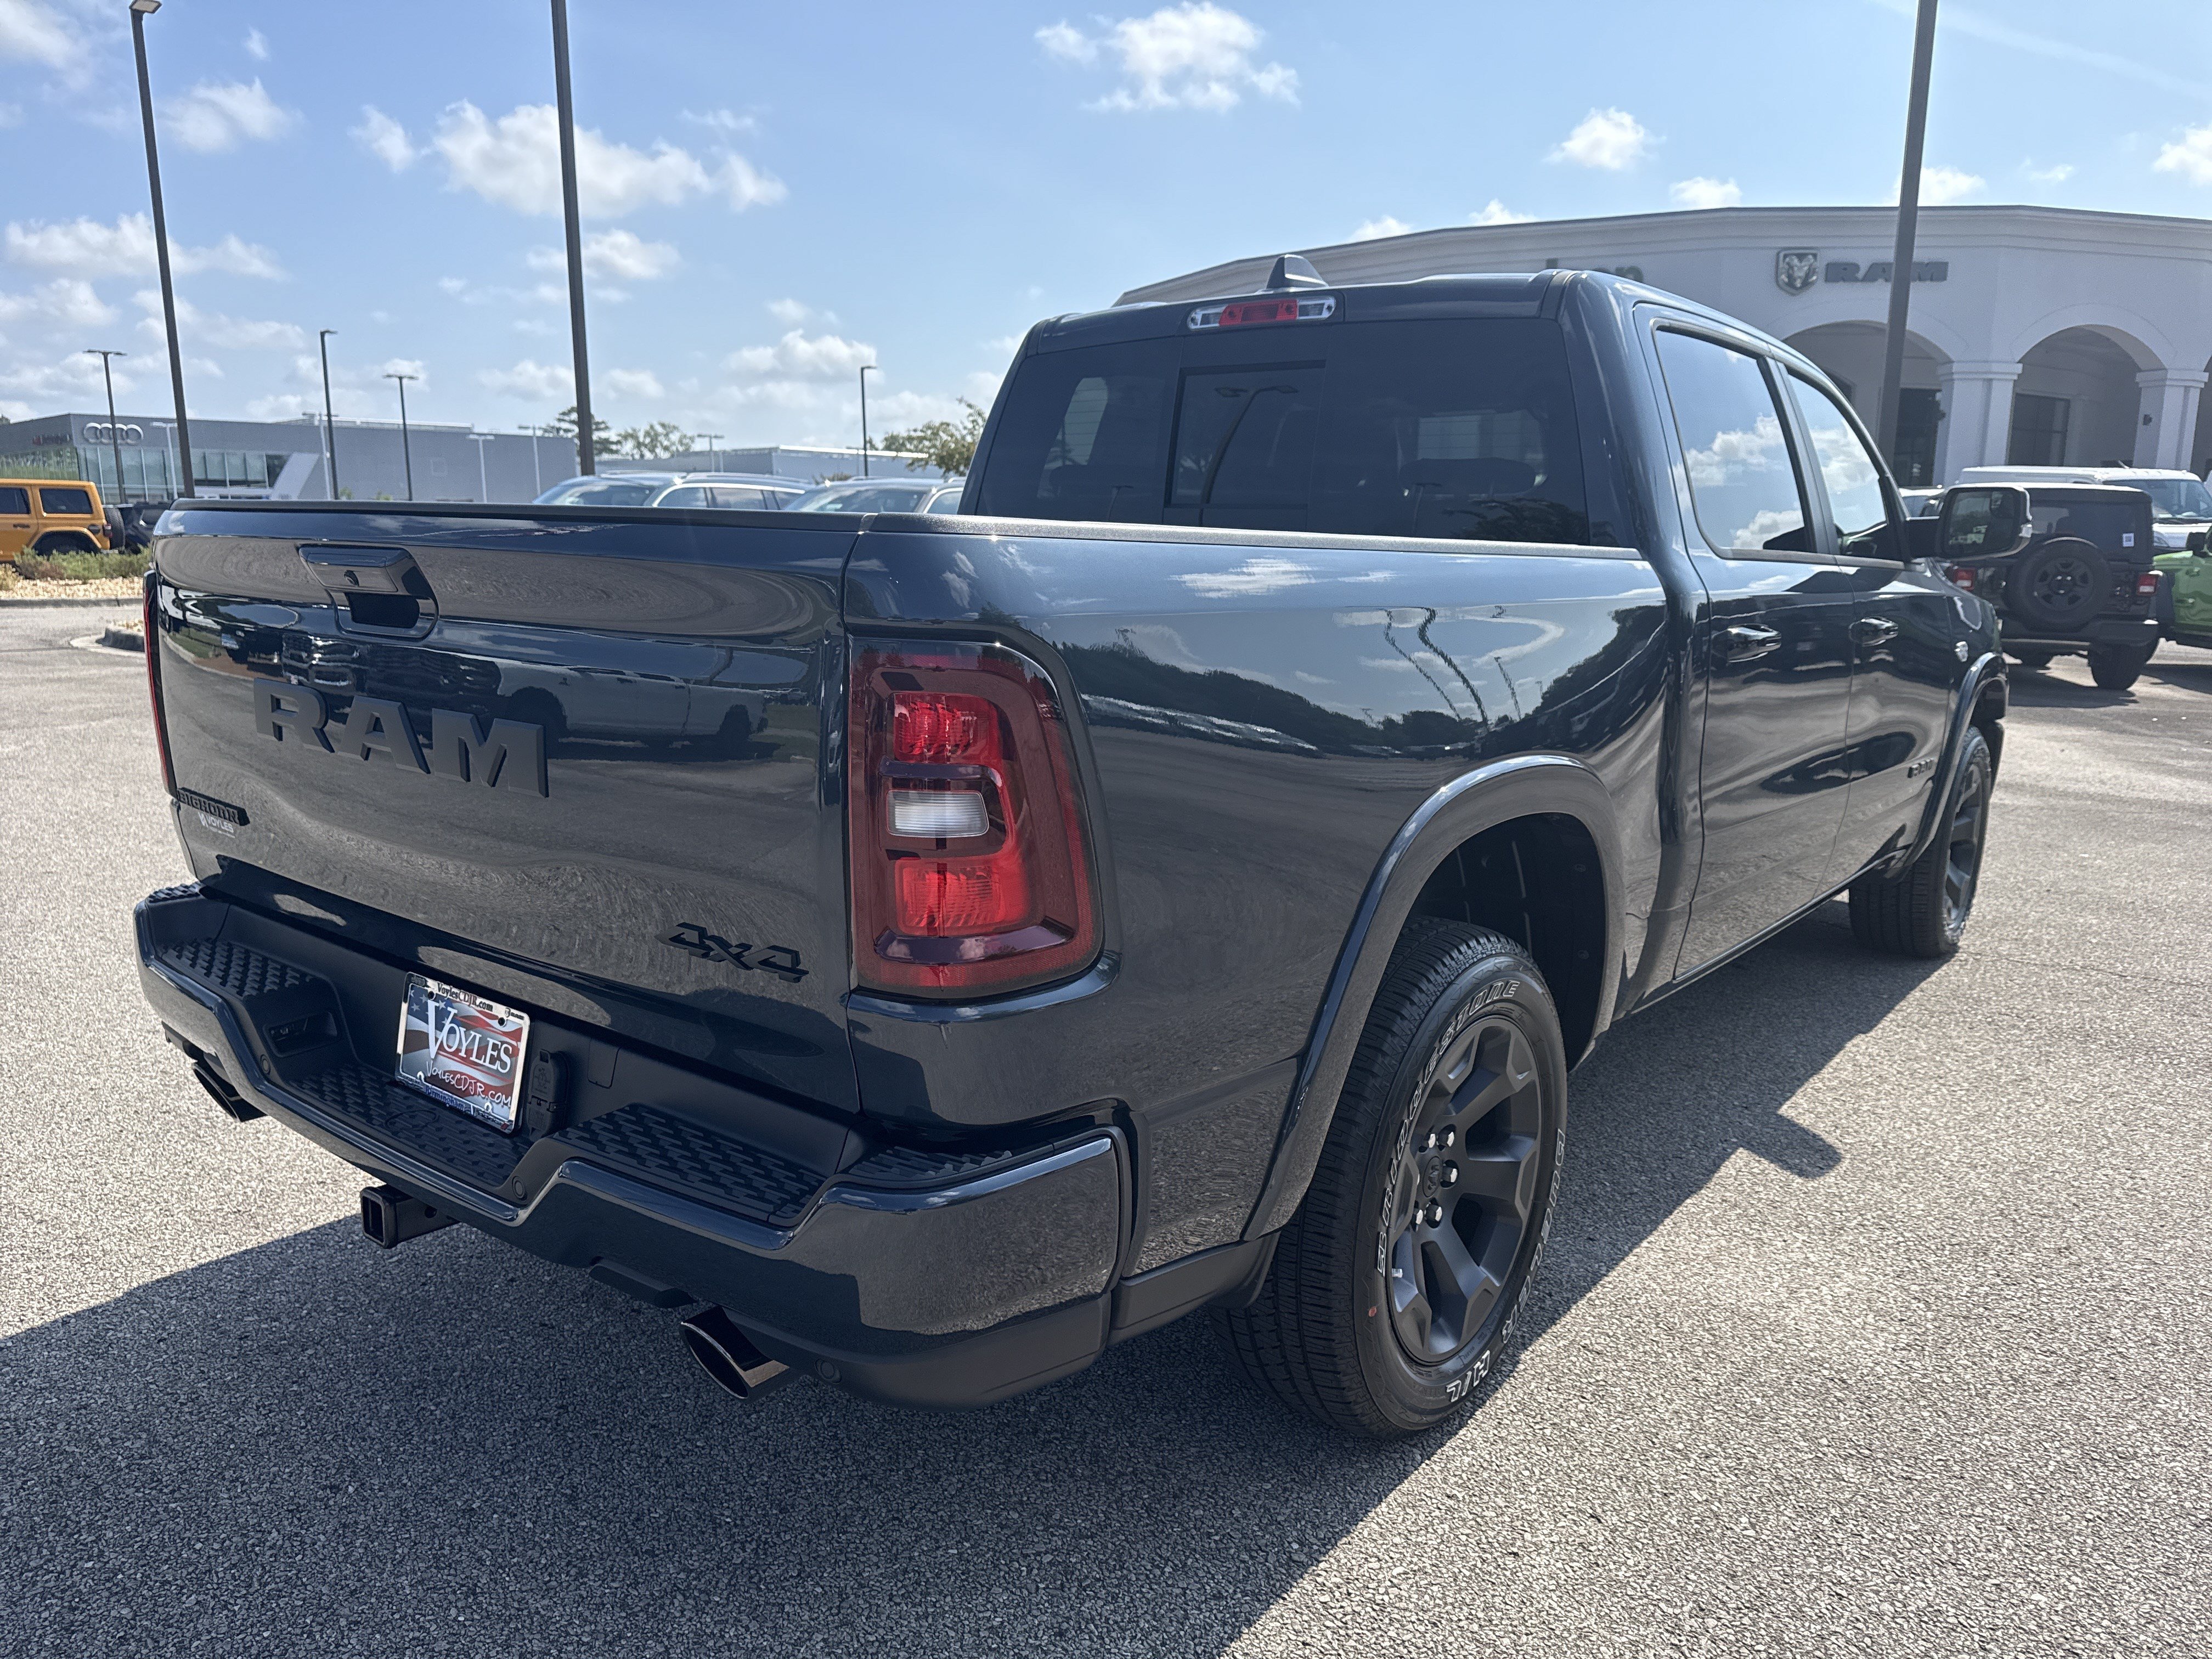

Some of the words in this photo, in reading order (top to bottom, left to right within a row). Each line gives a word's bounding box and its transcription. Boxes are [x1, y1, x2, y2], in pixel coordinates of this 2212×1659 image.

[1825, 261, 1949, 283] RAM
[253, 678, 549, 798] RAM
[427, 999, 512, 1074] VOYLES
[437, 981, 494, 1012] VoylesCDJR.com
[1376, 979, 1520, 1277] BRIDGESTONE
[1502, 1127, 1566, 1345] DUELER
